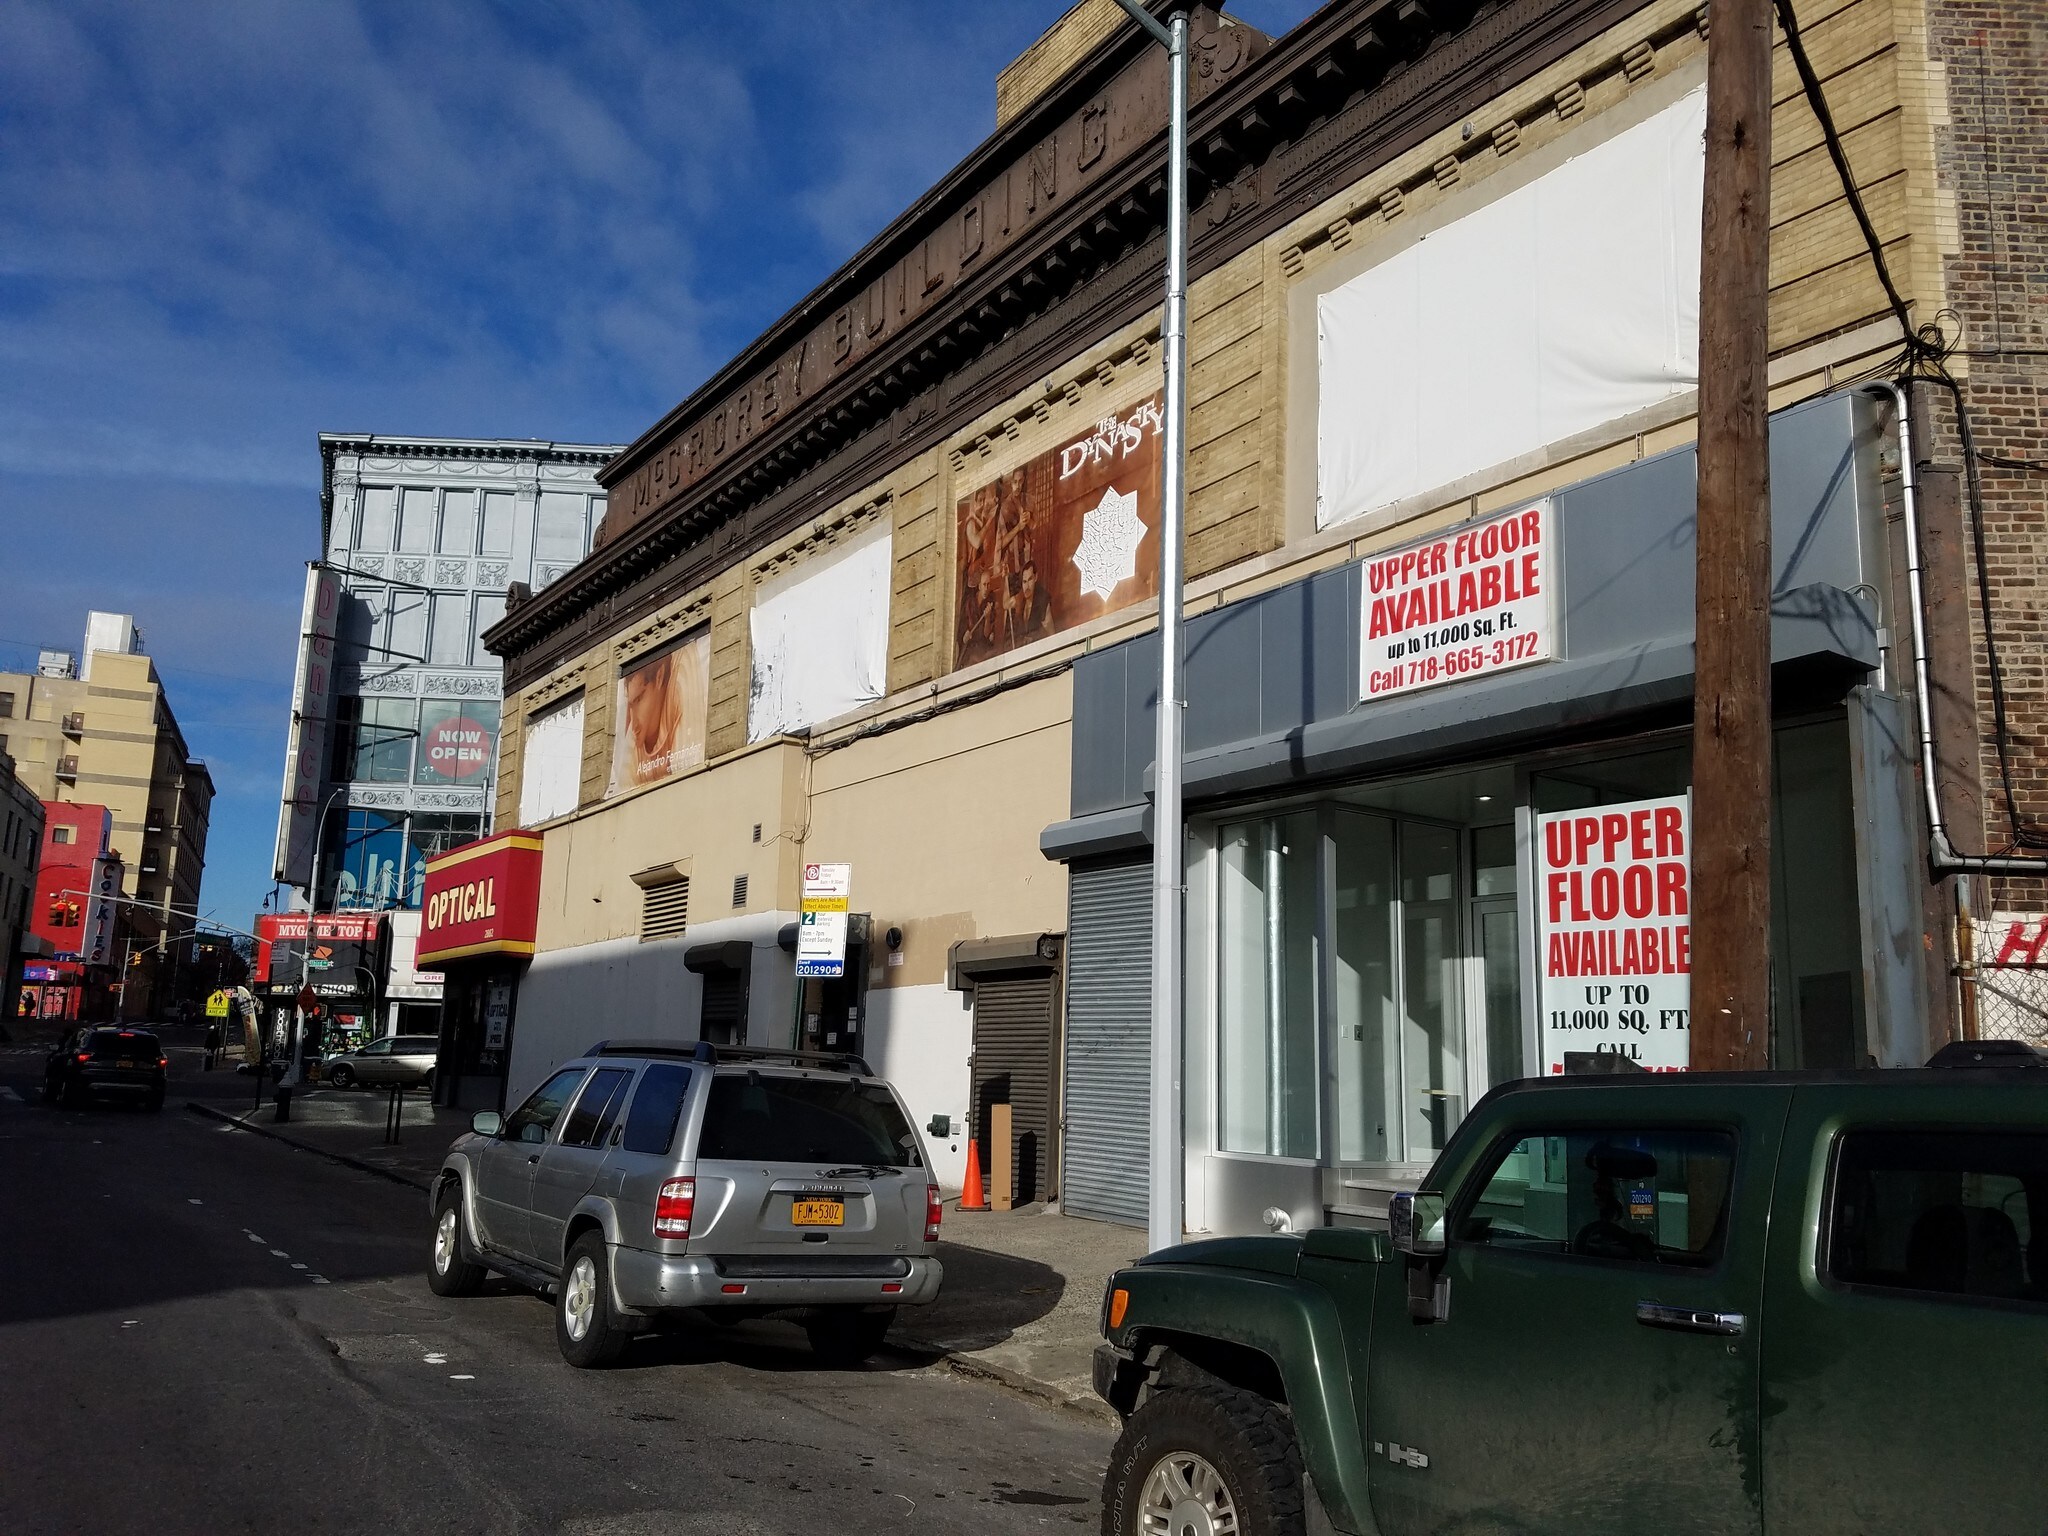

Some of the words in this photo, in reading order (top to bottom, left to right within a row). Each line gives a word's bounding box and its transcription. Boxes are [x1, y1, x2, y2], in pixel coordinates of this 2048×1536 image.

[834, 100, 1107, 367] BUILDING
[1059, 398, 1164, 480] DYNASTY
[1096, 415, 1118, 435] THE
[1369, 541, 1448, 595] UPPER
[1454, 509, 1541, 569] FLOOR
[1368, 550, 1540, 640] AVAILABLE
[1370, 664, 1404, 693] Call
[1408, 631, 1539, 685] 718-665-3172
[1387, 643, 1405, 660] up
[1408, 637, 1421, 653] to
[1423, 623, 1470, 650] 11,000
[1473, 619, 1496, 638] Sq.
[1500, 611, 1518, 631] Ft.
[430, 747, 482, 760] OPEN
[439, 730, 481, 743] NOW
[1545, 806, 1684, 868] UPPER
[427, 876, 496, 932] OPTICAL
[1547, 862, 1688, 923] FLOOR
[798, 965, 831, 974] 201290
[1548, 925, 1691, 978] AVAILABLE
[283, 983, 319, 994] PAN
[320, 983, 355, 995] SHOP
[1584, 985, 1612, 1005] UP
[1620, 984, 1650, 1005] TO
[1550, 1010, 1609, 1034] 11,000
[1618, 1009, 1650, 1034] SQ.
